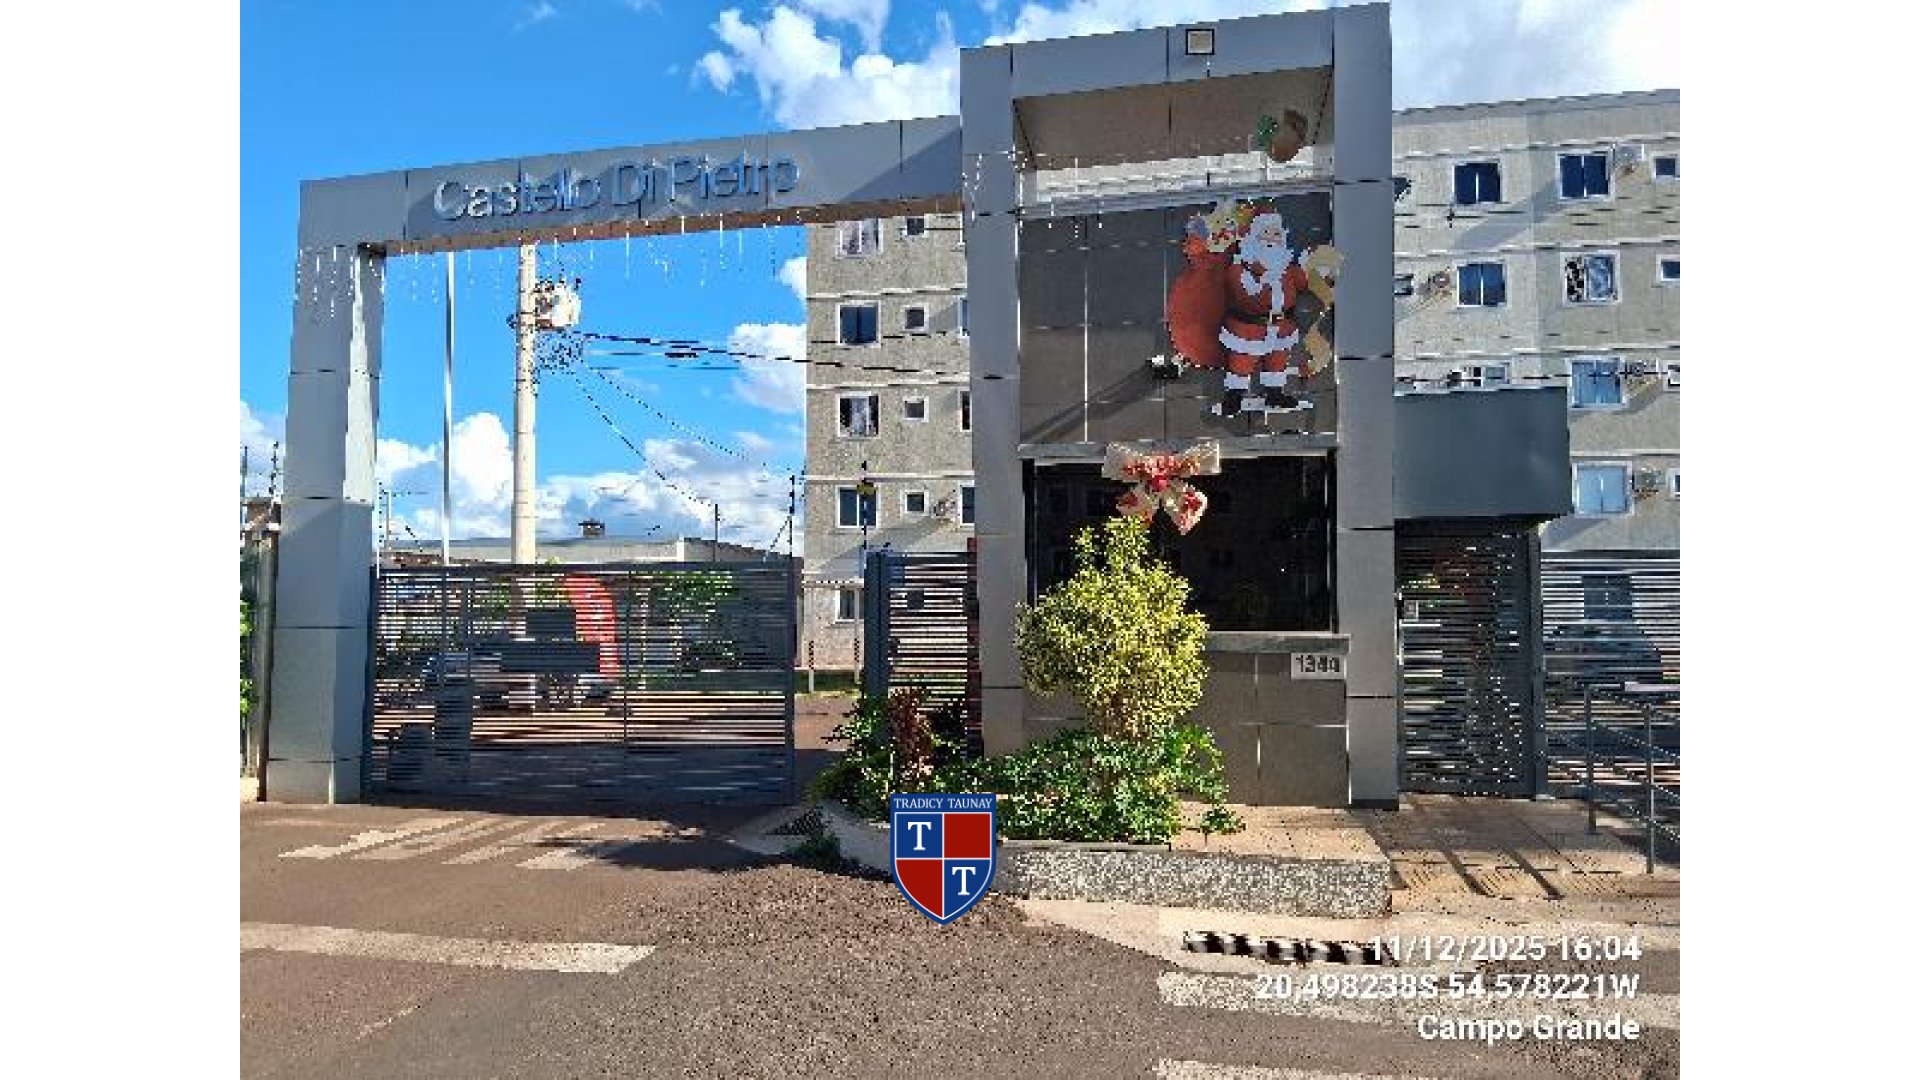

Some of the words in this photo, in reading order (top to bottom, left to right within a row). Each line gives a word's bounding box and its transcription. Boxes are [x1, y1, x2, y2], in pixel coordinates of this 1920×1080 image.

[433, 167, 601, 220] Castello
[612, 157, 655, 205] Di
[671, 150, 800, 202] Pietro
